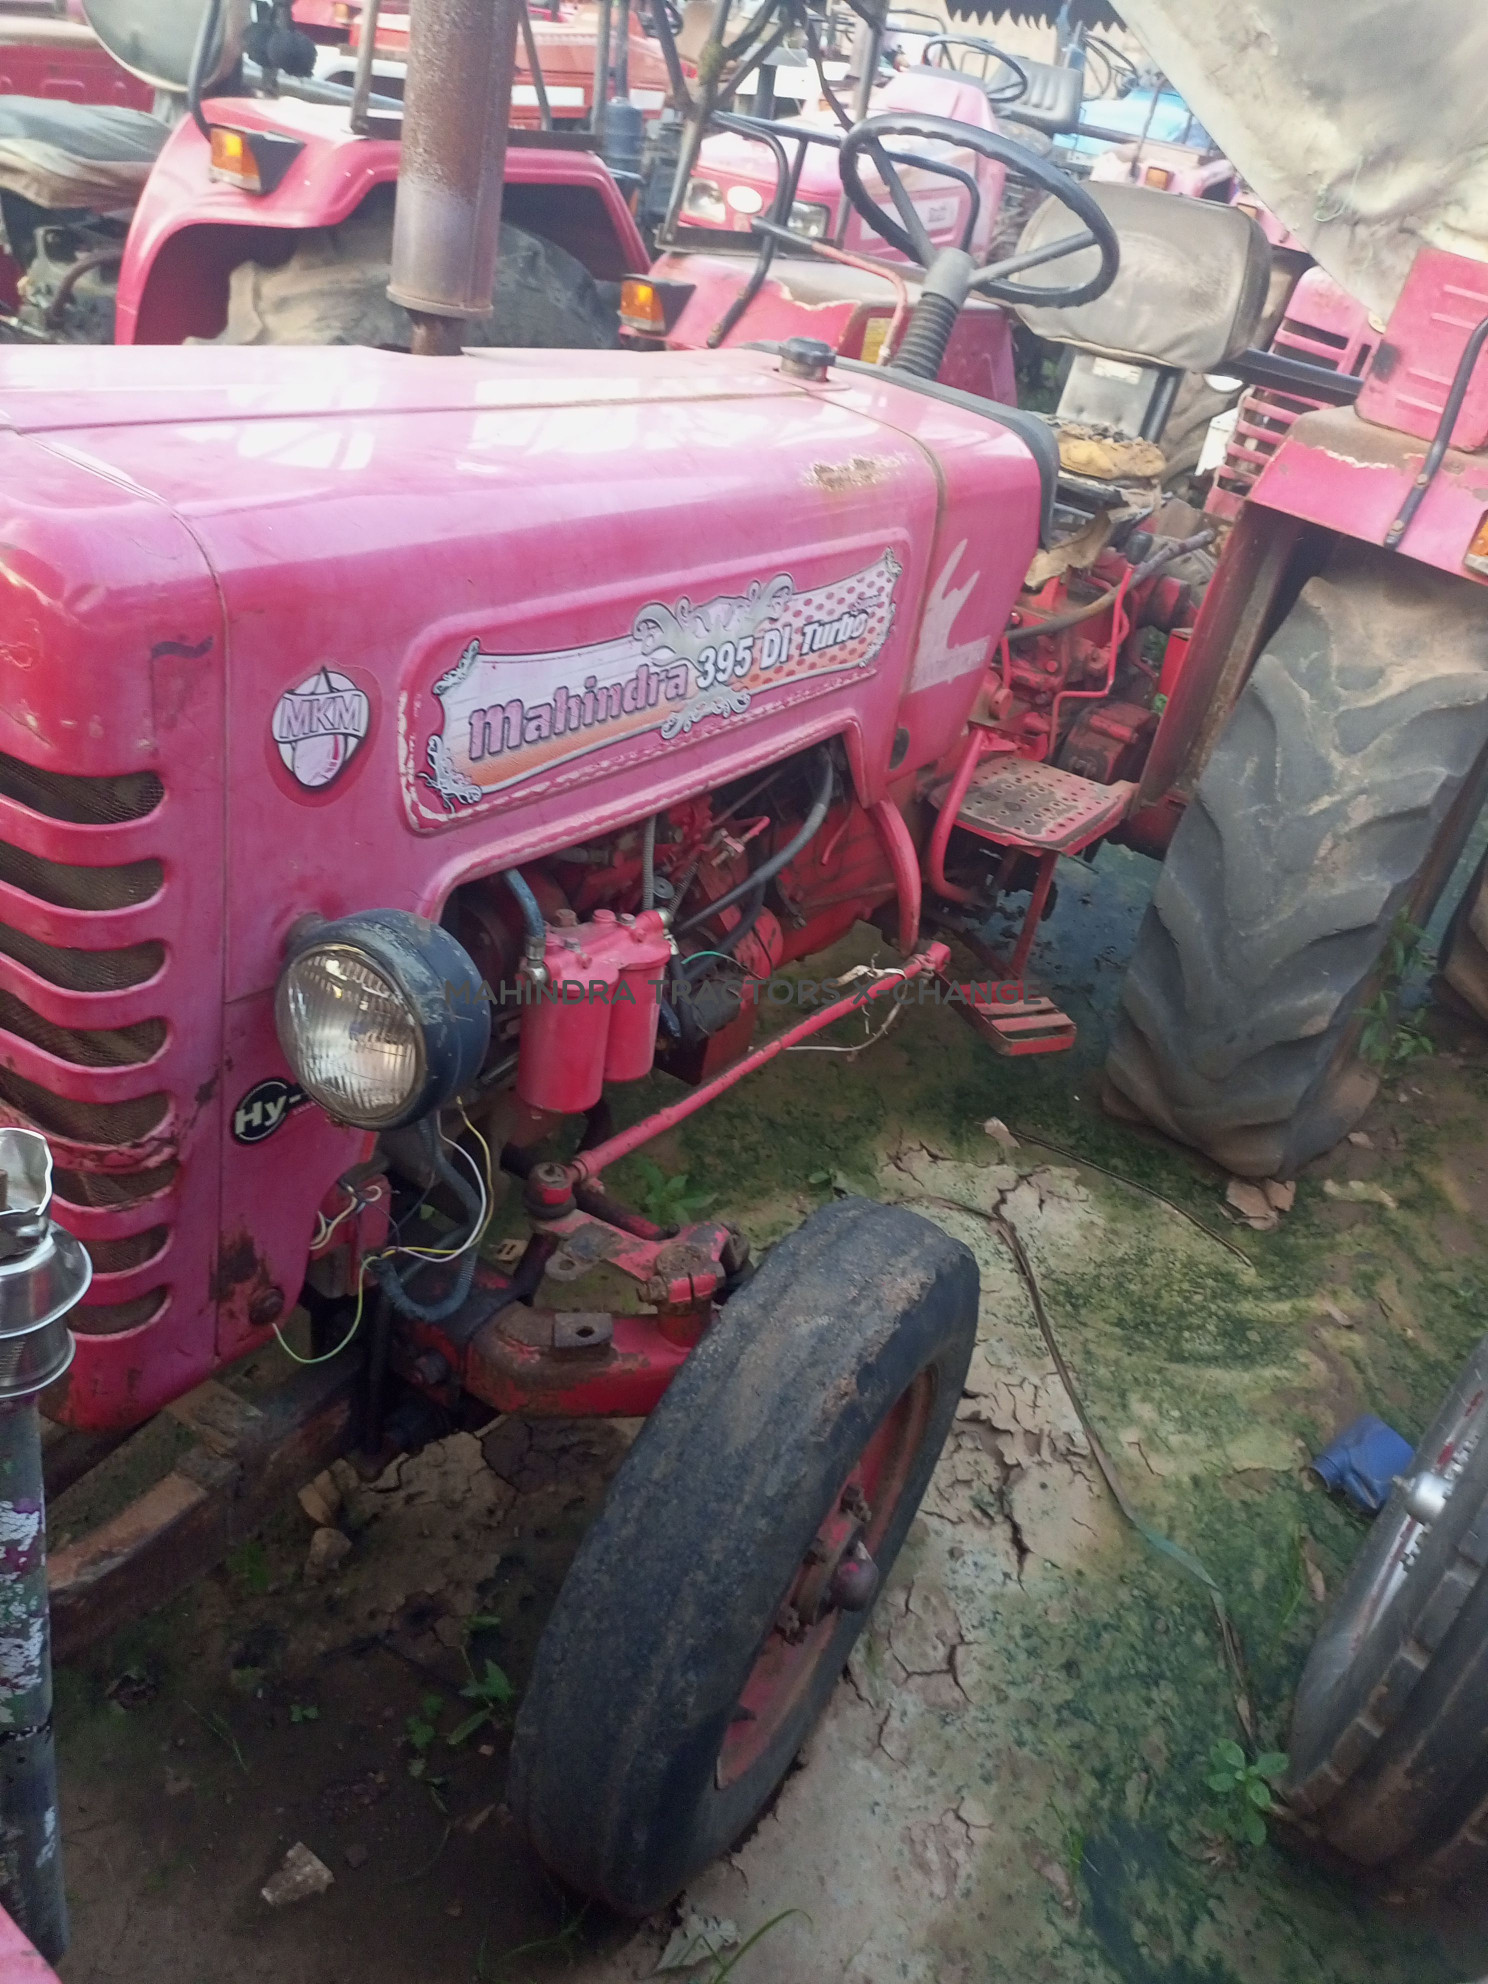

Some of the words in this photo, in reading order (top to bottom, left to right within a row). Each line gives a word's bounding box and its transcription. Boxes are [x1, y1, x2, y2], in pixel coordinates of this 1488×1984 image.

[695, 634, 755, 689] 395
[759, 623, 793, 670] DI
[799, 608, 869, 657] Turbo
[278, 693, 363, 739] MKM
